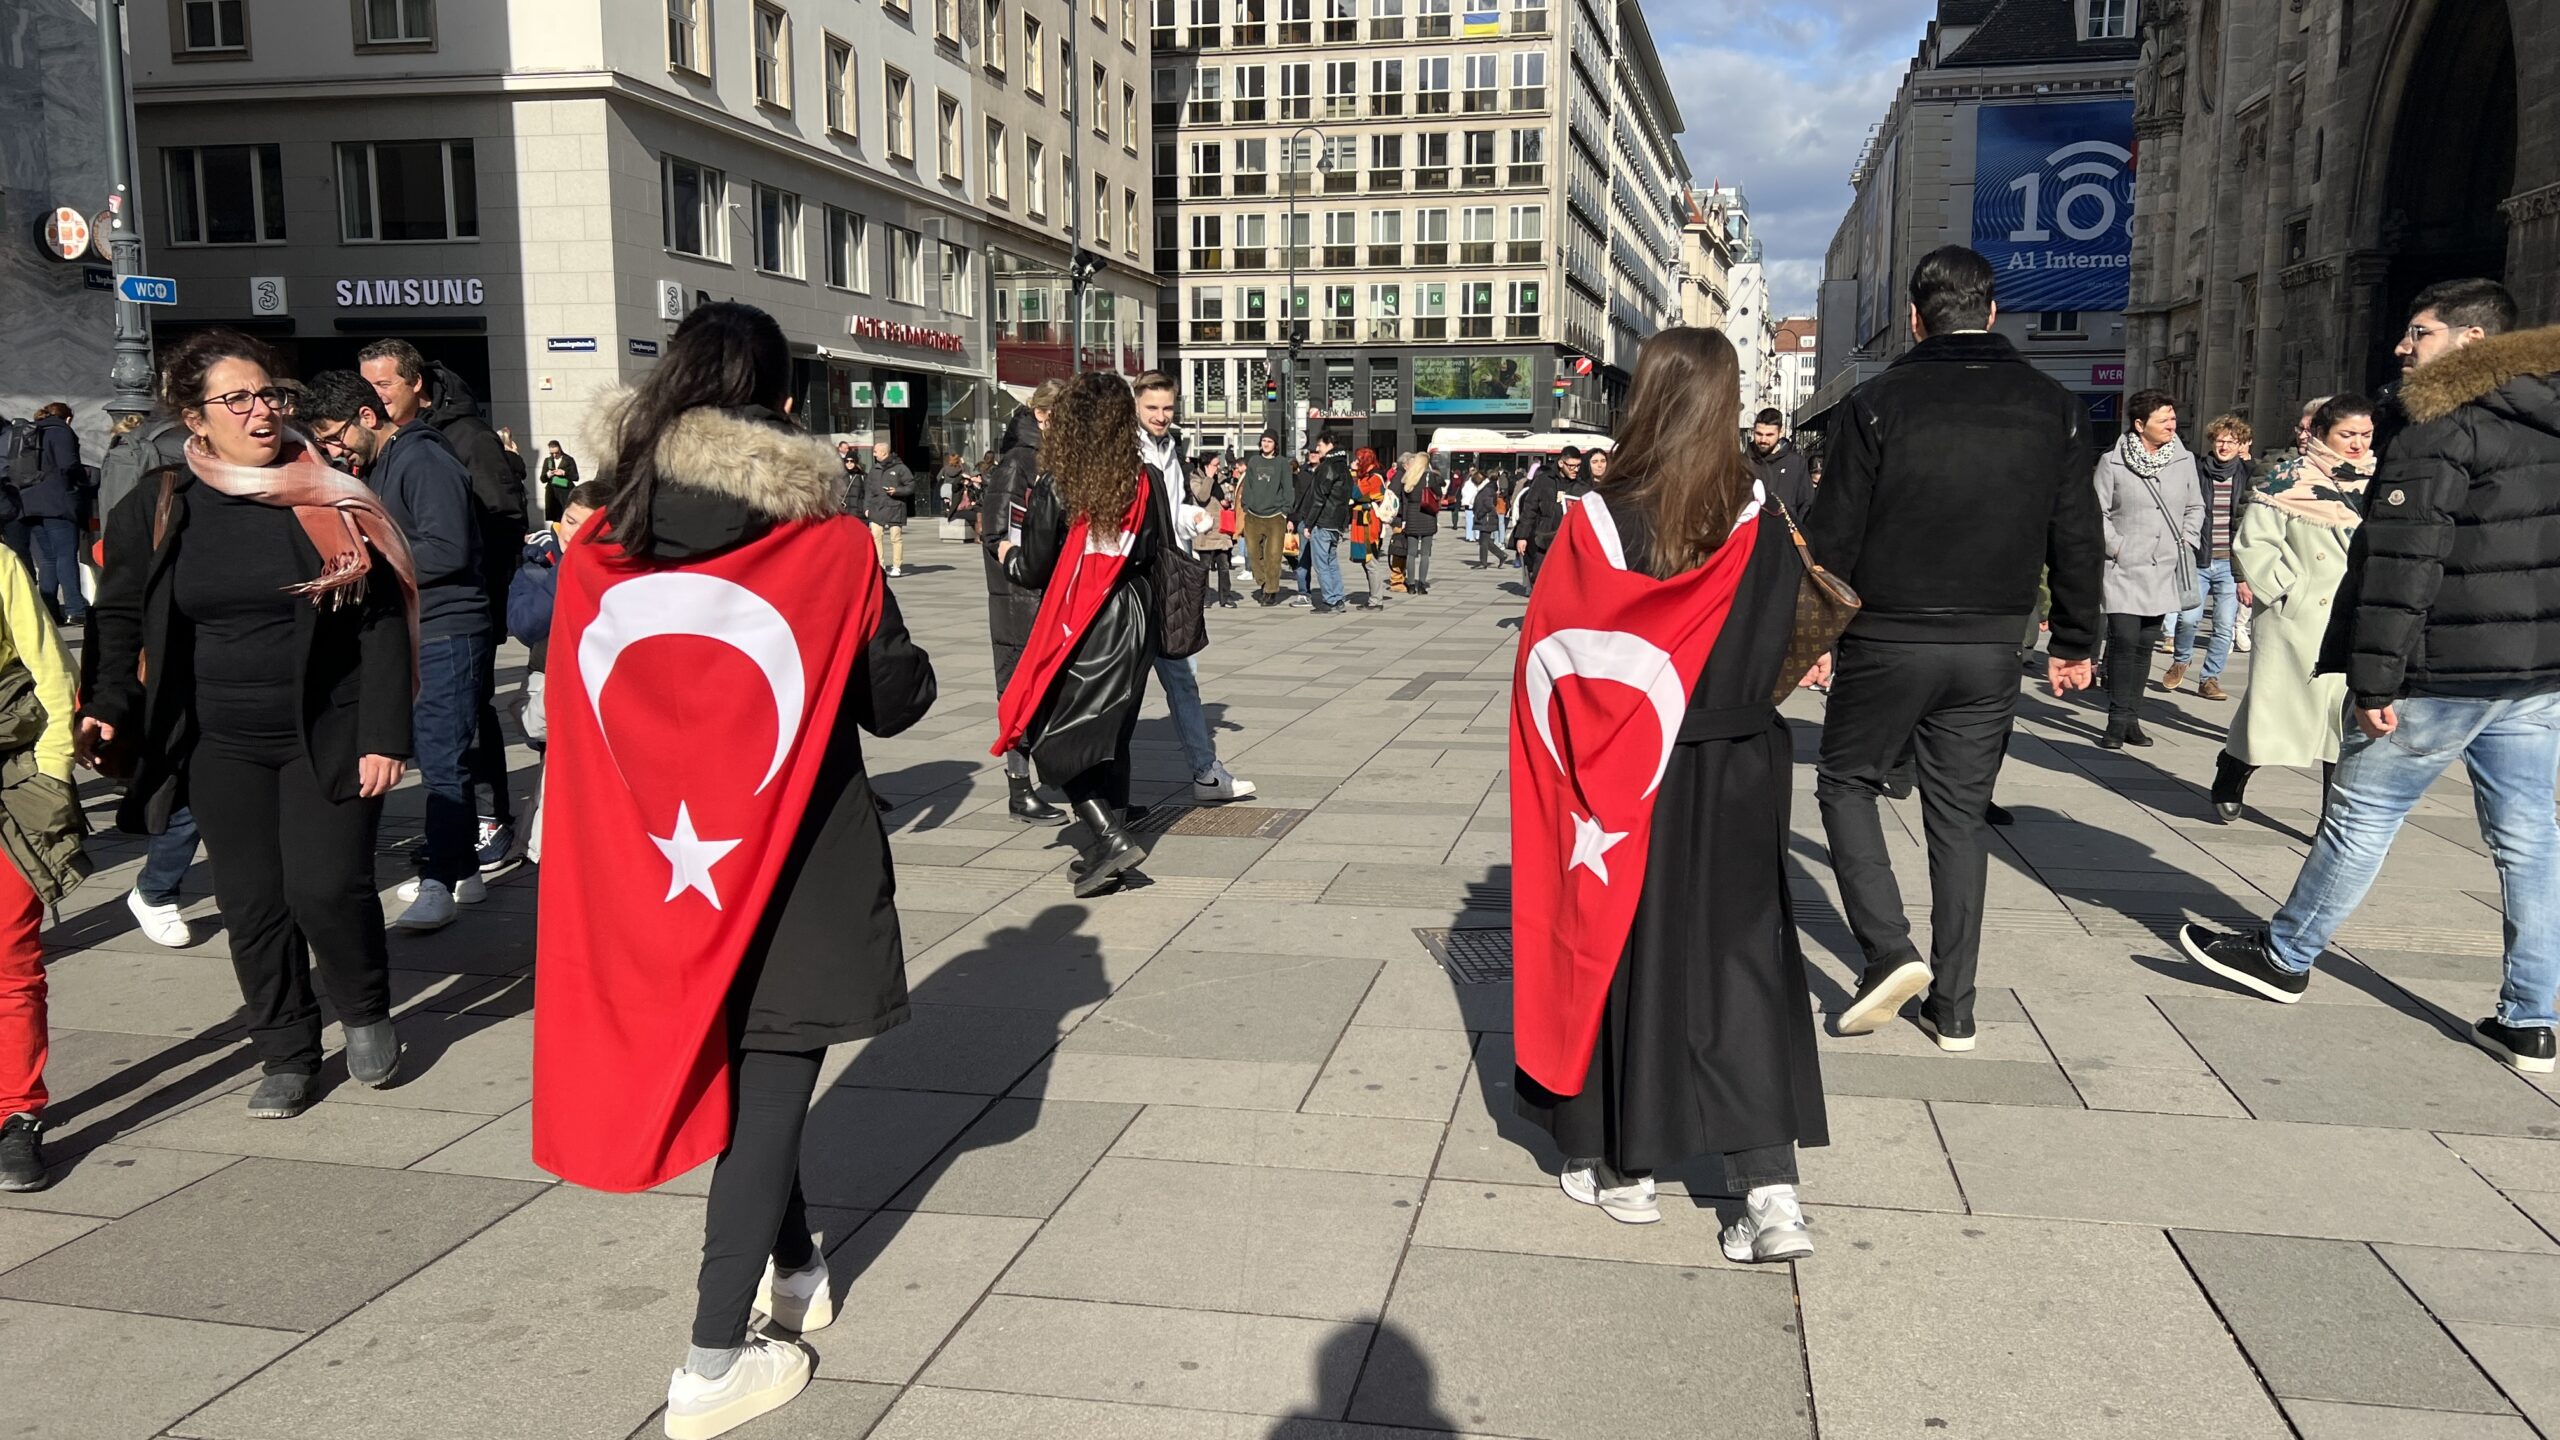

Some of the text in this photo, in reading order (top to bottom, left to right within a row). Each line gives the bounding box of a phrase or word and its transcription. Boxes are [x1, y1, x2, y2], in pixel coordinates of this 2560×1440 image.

[2007, 251, 2036, 270] A1
[134, 281, 155, 298] WC
[257, 280, 280, 311] 3
[336, 278, 484, 307] SAMSUNG
[667, 286, 679, 316] 3
[1320, 408, 1366, 417] Bank Austria
